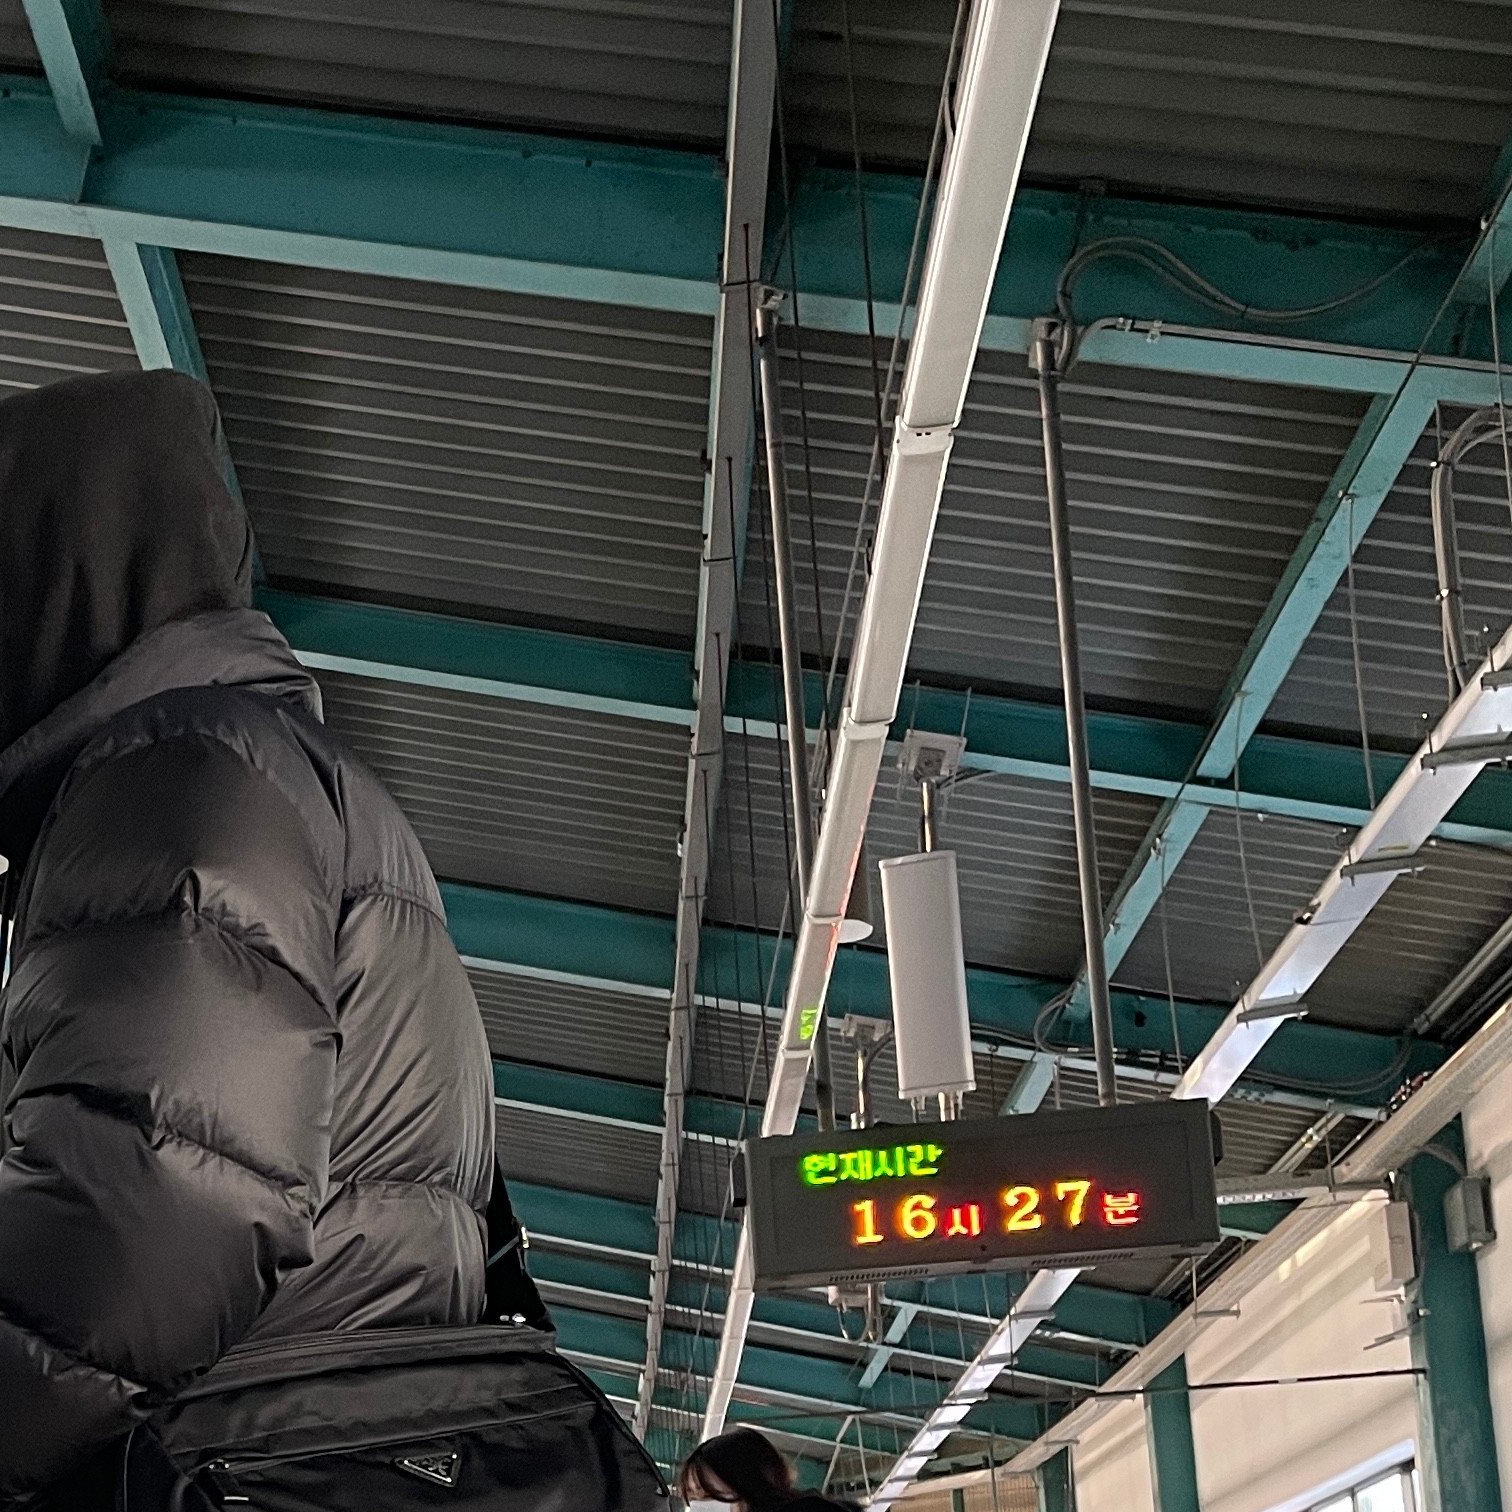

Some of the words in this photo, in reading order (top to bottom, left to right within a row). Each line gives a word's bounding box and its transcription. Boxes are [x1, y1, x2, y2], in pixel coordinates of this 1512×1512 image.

[801, 1143, 944, 1186] 현재시간
[850, 1194, 982, 1246] 16시
[1002, 1179, 1142, 1233] 27분
